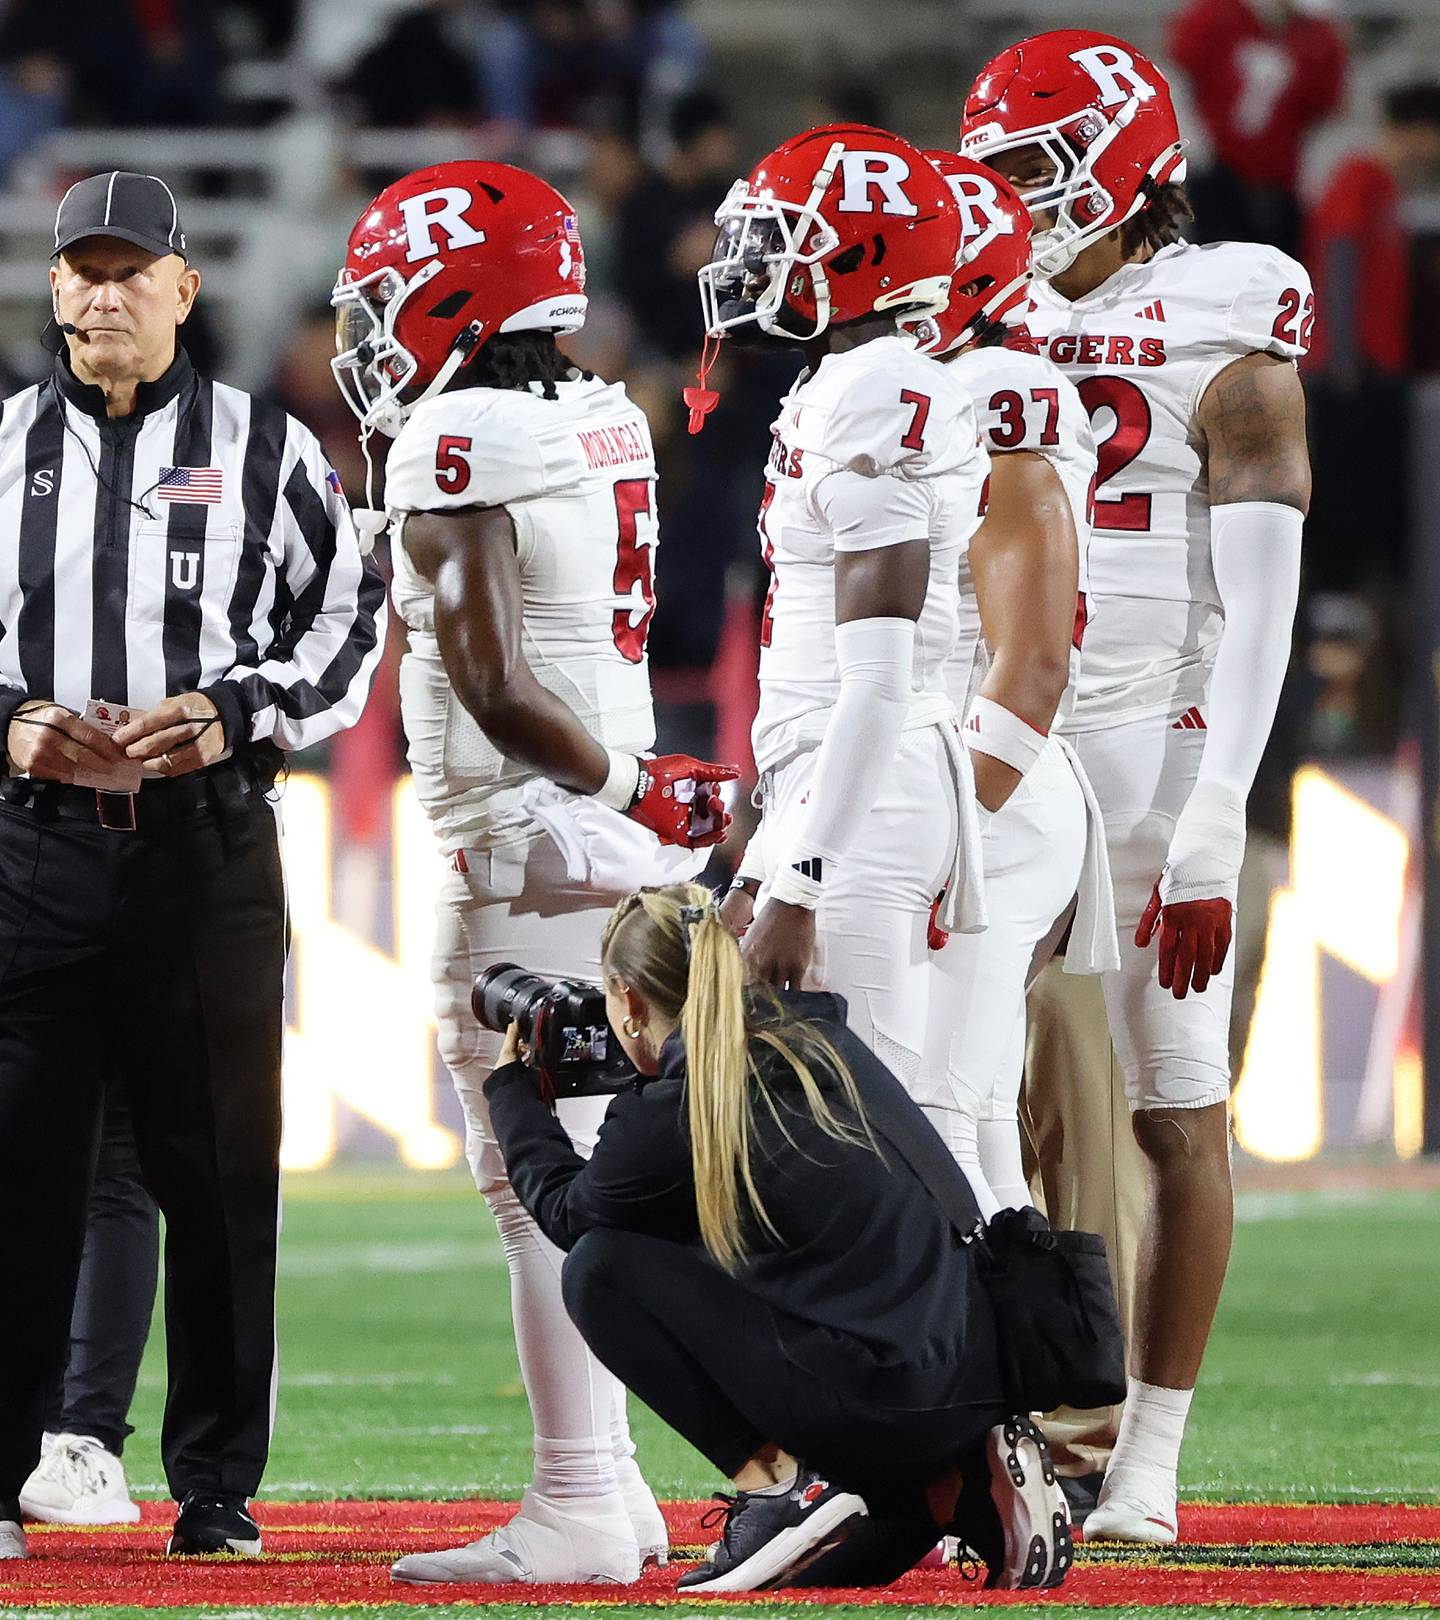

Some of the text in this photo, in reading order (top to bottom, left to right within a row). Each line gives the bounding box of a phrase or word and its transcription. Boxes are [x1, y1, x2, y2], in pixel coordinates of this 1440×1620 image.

[1068, 44, 1157, 109] R
[838, 149, 919, 218] R
[943, 173, 1015, 238] R
[397, 186, 488, 264] R
[1270, 287, 1316, 350] 22
[900, 387, 931, 453] 7
[988, 387, 1060, 448] 37
[435, 434, 473, 495] 5
[169, 550, 201, 590] U
[611, 477, 657, 665] 5
